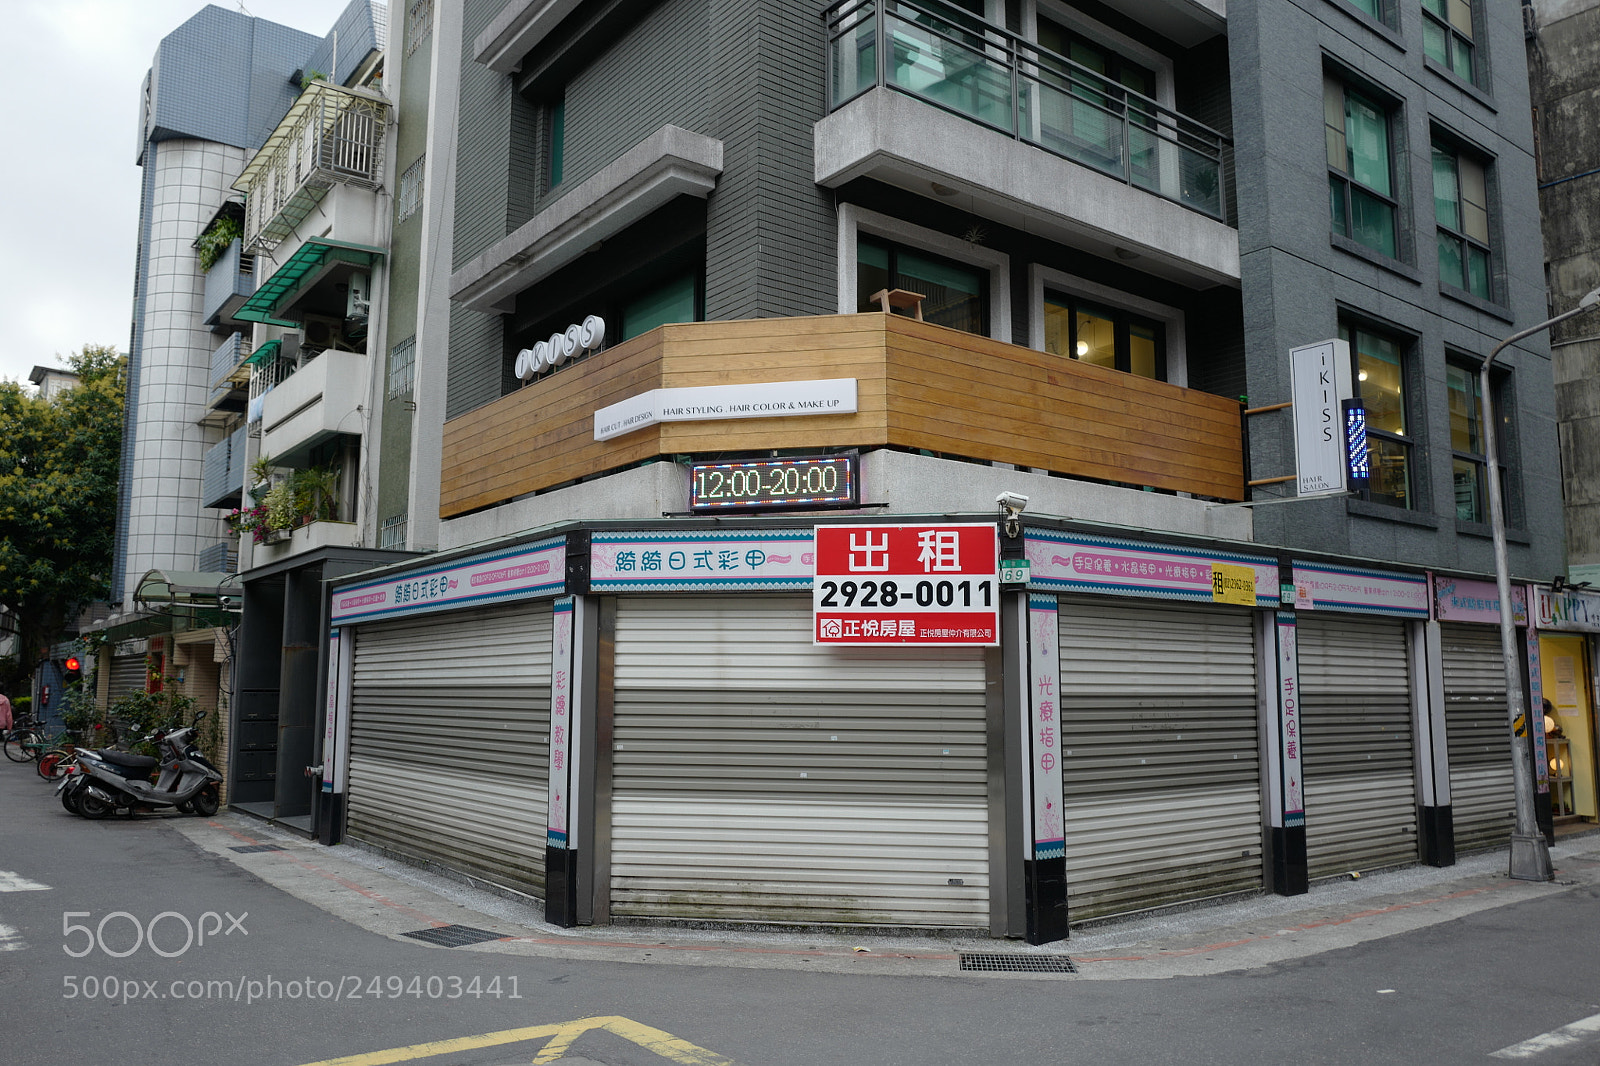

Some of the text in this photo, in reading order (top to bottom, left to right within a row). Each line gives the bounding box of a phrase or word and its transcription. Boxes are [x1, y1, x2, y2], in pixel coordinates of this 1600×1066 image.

[519, 319, 594, 374] iKISS
[663, 407, 684, 416] HAIR
[686, 405, 723, 414] STYLING
[729, 404, 750, 412] HAIR
[753, 402, 786, 411] COLOR
[788, 401, 796, 409] &
[798, 400, 824, 408] MAKE
[827, 399, 840, 408] UP
[1320, 352, 1332, 442] iKISS
[698, 466, 837, 498] 12:00-20:00
[1302, 475, 1323, 484] HAIR
[1303, 482, 1330, 492] SALON
[615, 550, 766, 571] 綺綺日式彩甲
[1005, 570, 1023, 580] 69
[1213, 571, 1224, 594] 租
[820, 580, 991, 607] 2928-0011
[843, 620, 915, 637] 正悅房屋
[920, 628, 992, 638] 正悅房屋仲介有限公司
[1039, 675, 1055, 774] 光療指甲
[1284, 677, 1297, 759] 手足保養
